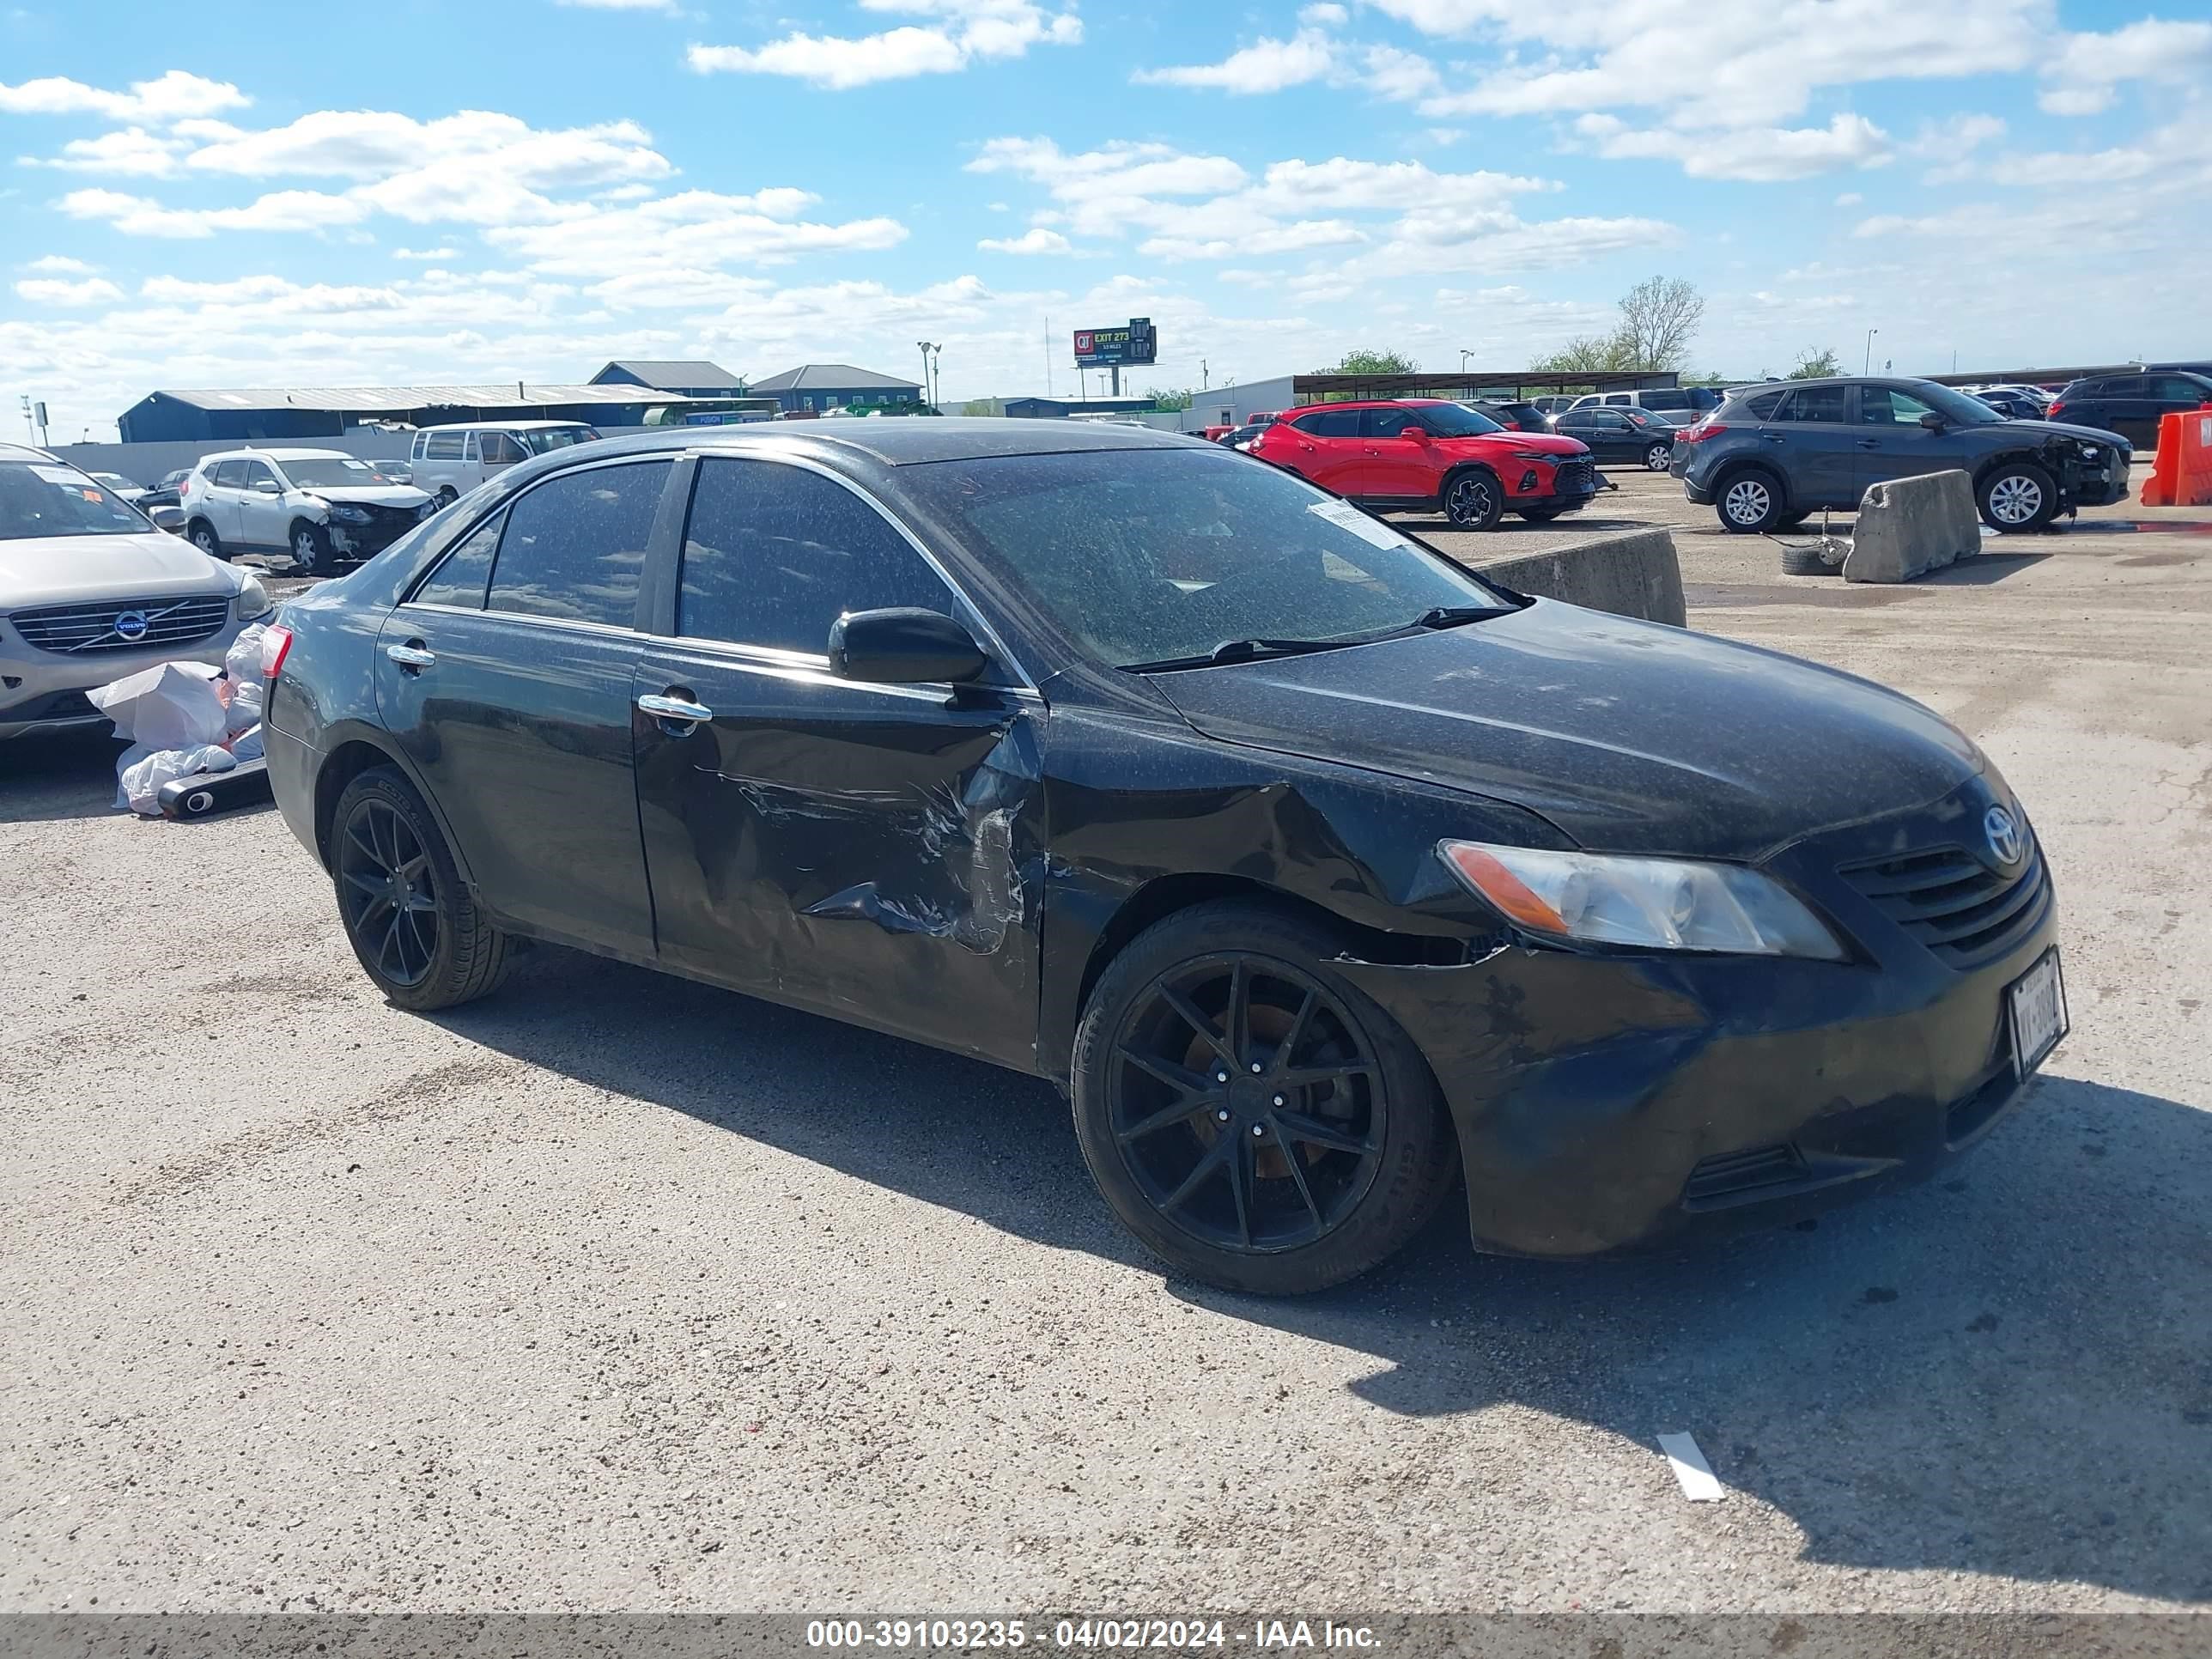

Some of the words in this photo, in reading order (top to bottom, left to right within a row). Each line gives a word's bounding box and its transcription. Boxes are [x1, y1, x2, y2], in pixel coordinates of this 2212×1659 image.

[1078, 336, 1091, 349] QT
[1094, 333, 1113, 343] EXIT
[1114, 332, 1129, 342] 273
